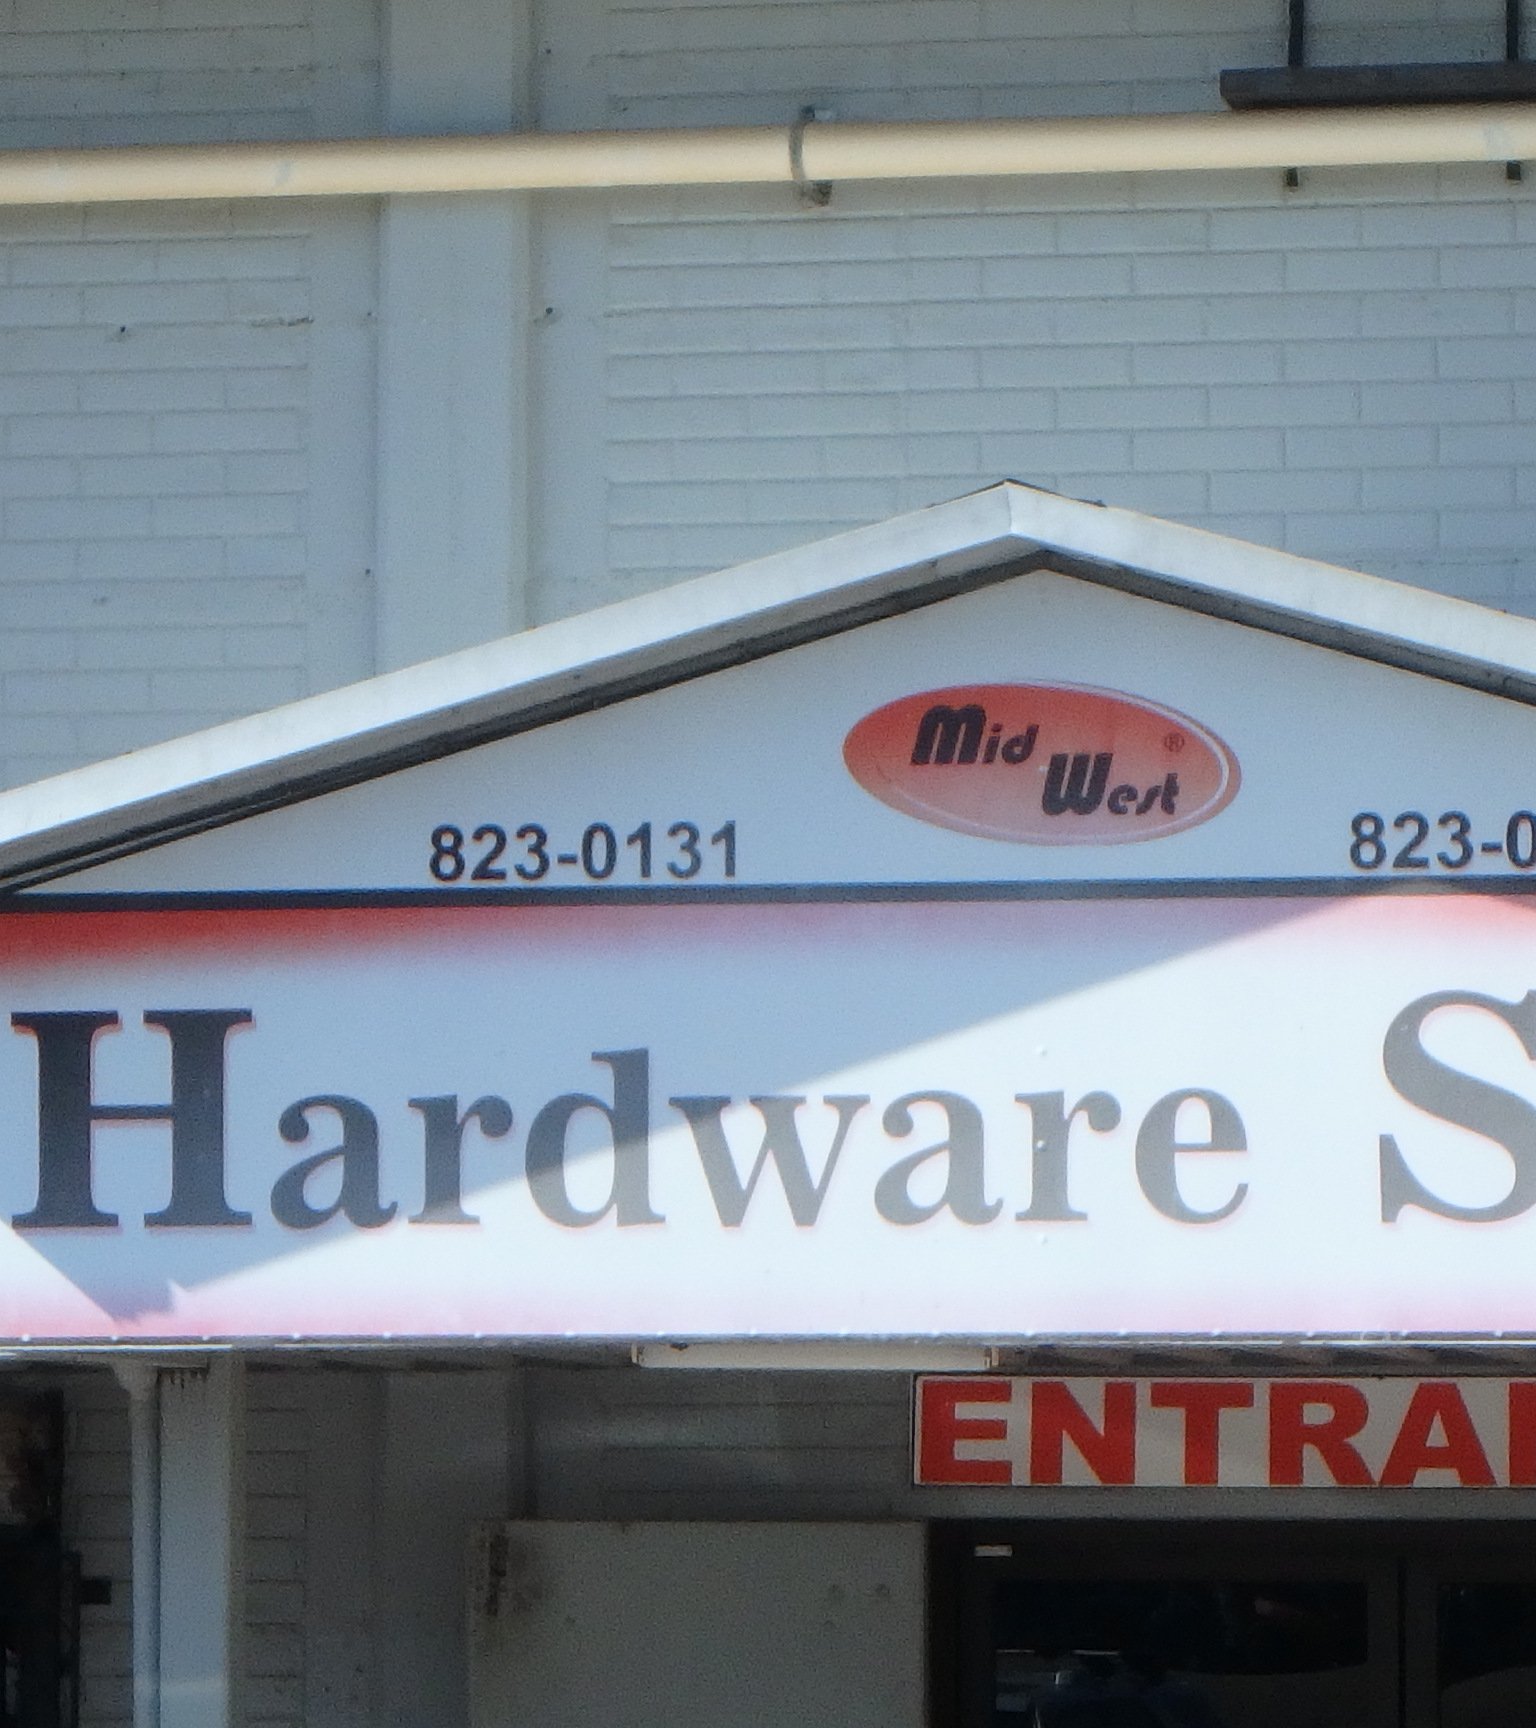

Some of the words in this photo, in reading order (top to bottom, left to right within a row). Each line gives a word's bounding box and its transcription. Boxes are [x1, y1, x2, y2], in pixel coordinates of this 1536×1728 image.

[910, 703, 1040, 767] Mid
[1041, 752, 1180, 816] West
[428, 820, 740, 884] 823-0131
[10, 1006, 1250, 1232] Hardware
